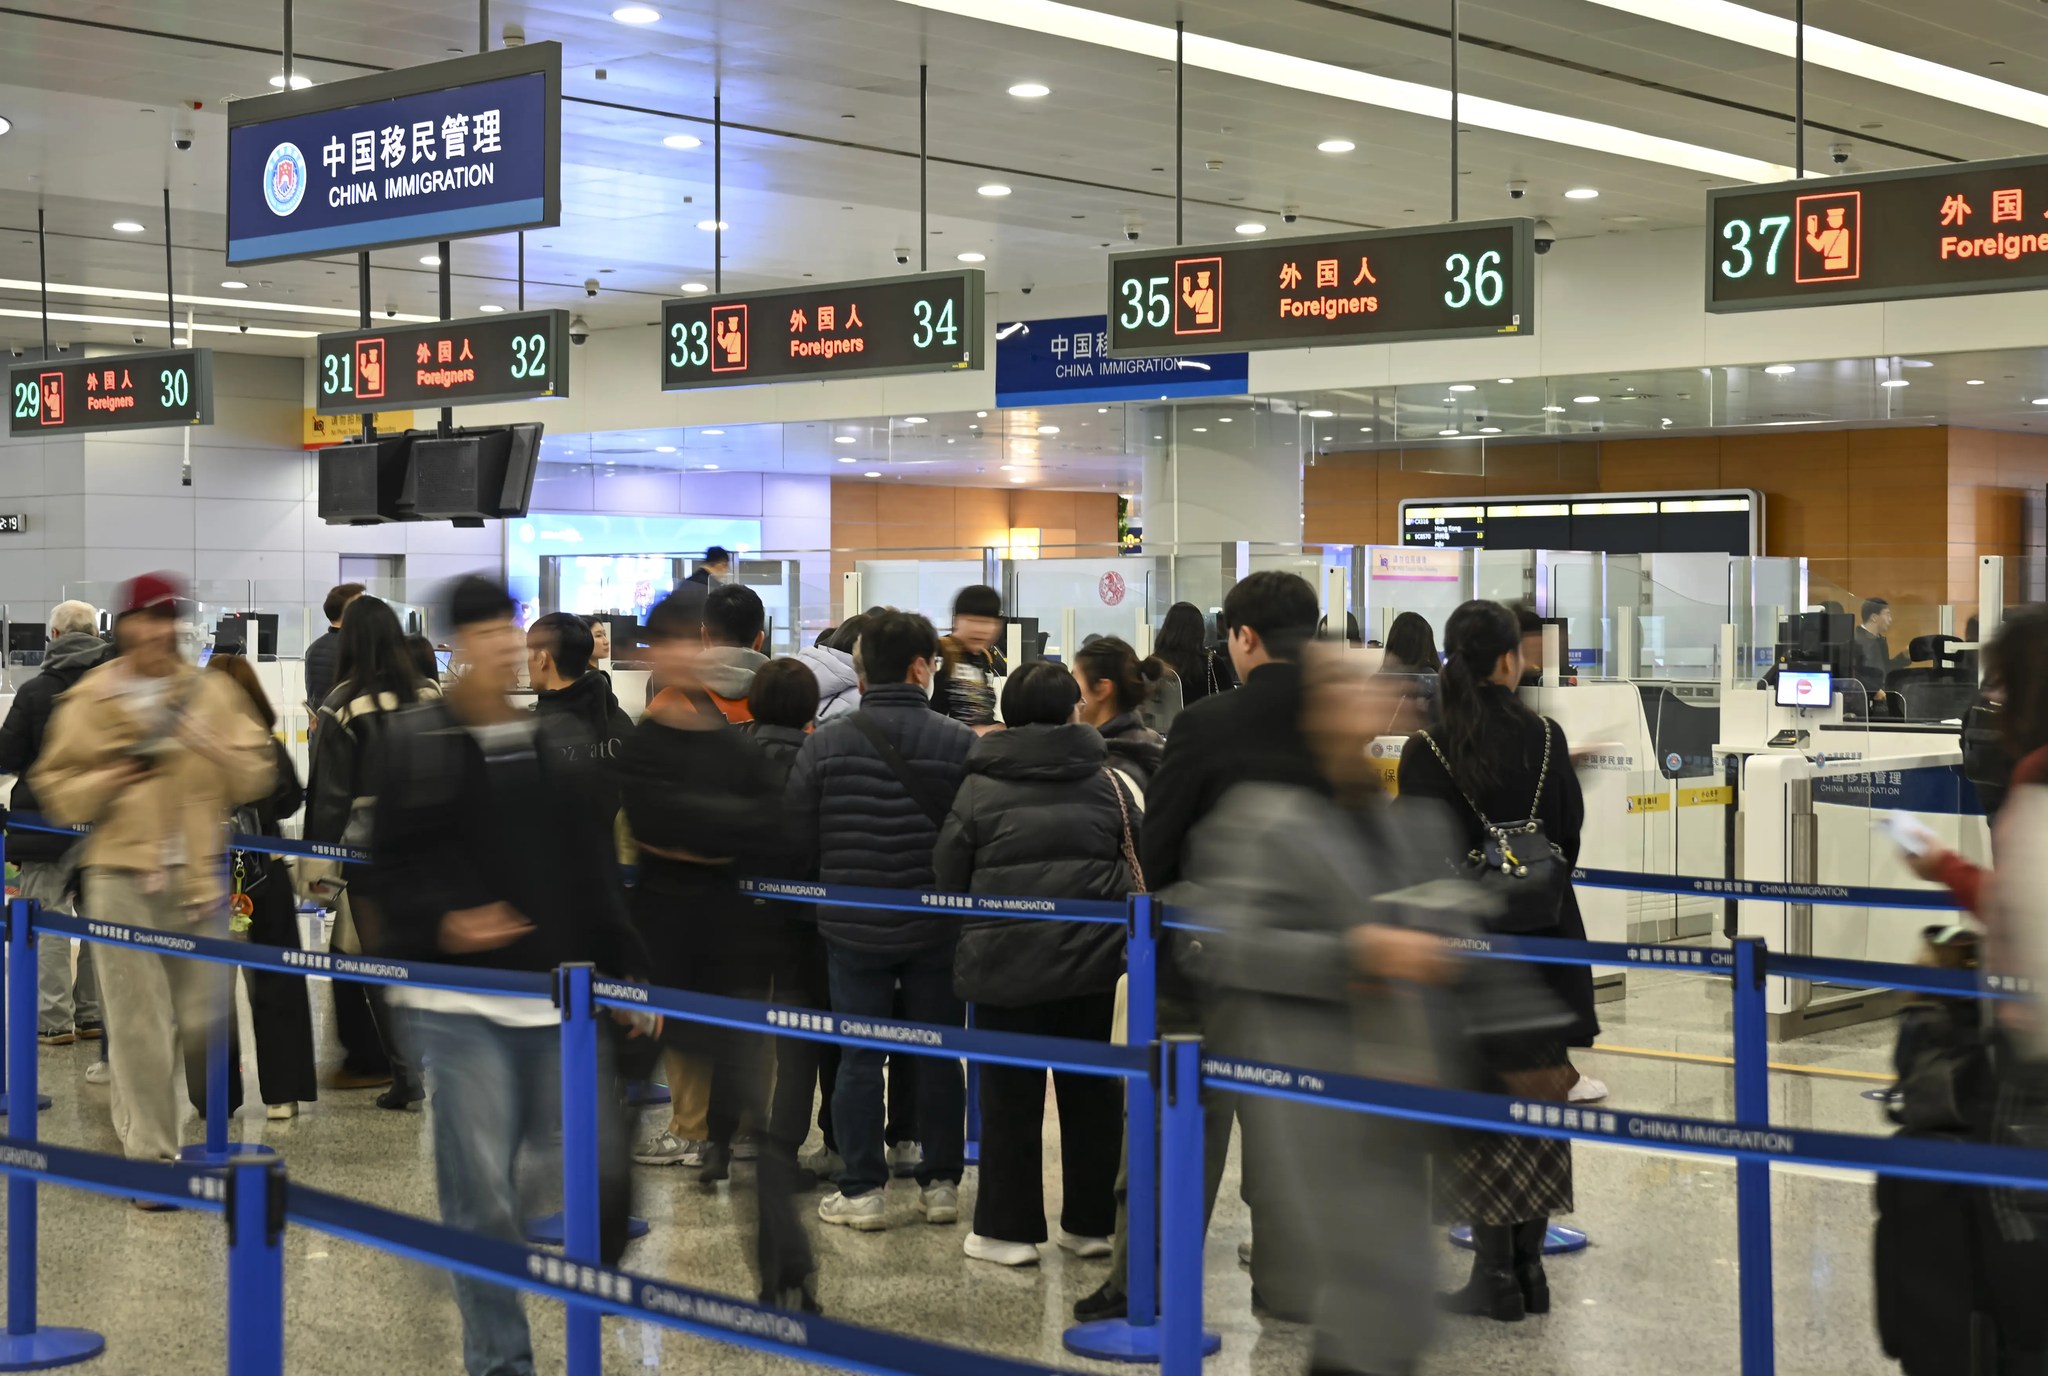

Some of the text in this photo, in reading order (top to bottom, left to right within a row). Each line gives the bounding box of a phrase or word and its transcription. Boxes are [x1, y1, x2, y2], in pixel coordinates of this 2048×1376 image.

[323, 109, 502, 178] 中国移民管理
[328, 162, 494, 208] CHINA IMMIGRATION
[1940, 188, 2048, 226] 外国
[1721, 215, 1790, 278] 37
[1279, 256, 1376, 289] 外国人
[1444, 250, 1503, 308] 36
[1120, 276, 1170, 329] 35
[1280, 296, 1378, 320] Foreigners
[789, 304, 863, 333] 外国人
[913, 298, 958, 348] 34
[416, 338, 474, 364] 外国人
[511, 334, 546, 379] 32
[670, 320, 708, 368] 33
[790, 337, 864, 359] Foreigners
[86, 369, 133, 391] 外国人
[323, 353, 353, 394] 31
[416, 367, 475, 388] Foreigners
[1055, 357, 1183, 378] CHINA IMMIGRATION
[15, 381, 40, 418] 29
[160, 368, 189, 407] 30
[87, 395, 134, 412] Foreigners
[1820, 784, 1900, 795] CHINA IMMIGRATION
[759, 882, 826, 897] CHINA IMMIGRATION
[1759, 884, 1848, 898] CHINA IMMIGRATION
[335, 958, 409, 979] CHINA IMMIGRATION
[839, 1019, 872, 1038] CHINA
[1233, 1063, 1325, 1092] IMMIGRAION
[1628, 1117, 1795, 1153] CHINA IMMIGRATION
